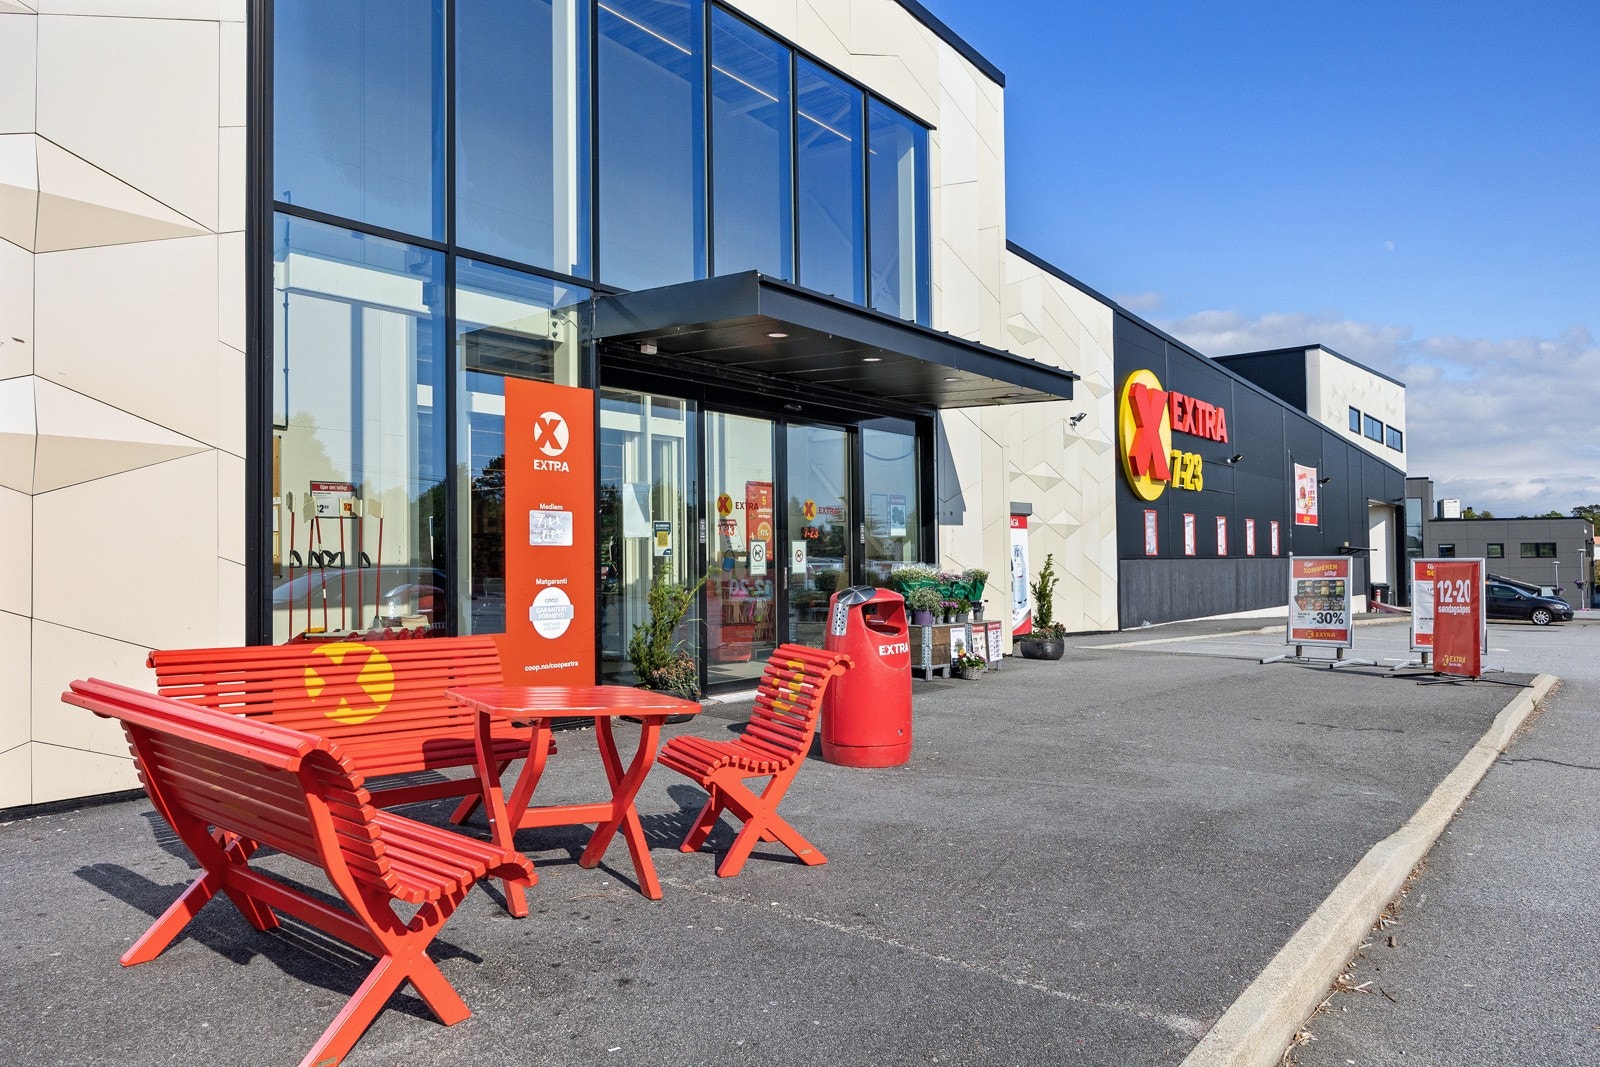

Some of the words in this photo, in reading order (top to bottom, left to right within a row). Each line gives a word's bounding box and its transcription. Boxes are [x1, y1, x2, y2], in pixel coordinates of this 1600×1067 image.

[1168, 390, 1229, 444] EXTRA
[533, 459, 570, 473] EXTRA
[1170, 449, 1203, 492] 7-23
[735, 501, 760, 511] EXTRA
[819, 506, 839, 515] EXTRA
[1303, 563, 1338, 574] SOMMEREN
[535, 577, 568, 587] Matgaranti
[1437, 579, 1470, 603] 12-20
[1312, 611, 1344, 625] -30%
[879, 642, 909, 656] EXTRA
[524, 660, 579, 672] coop.no/coopextra
